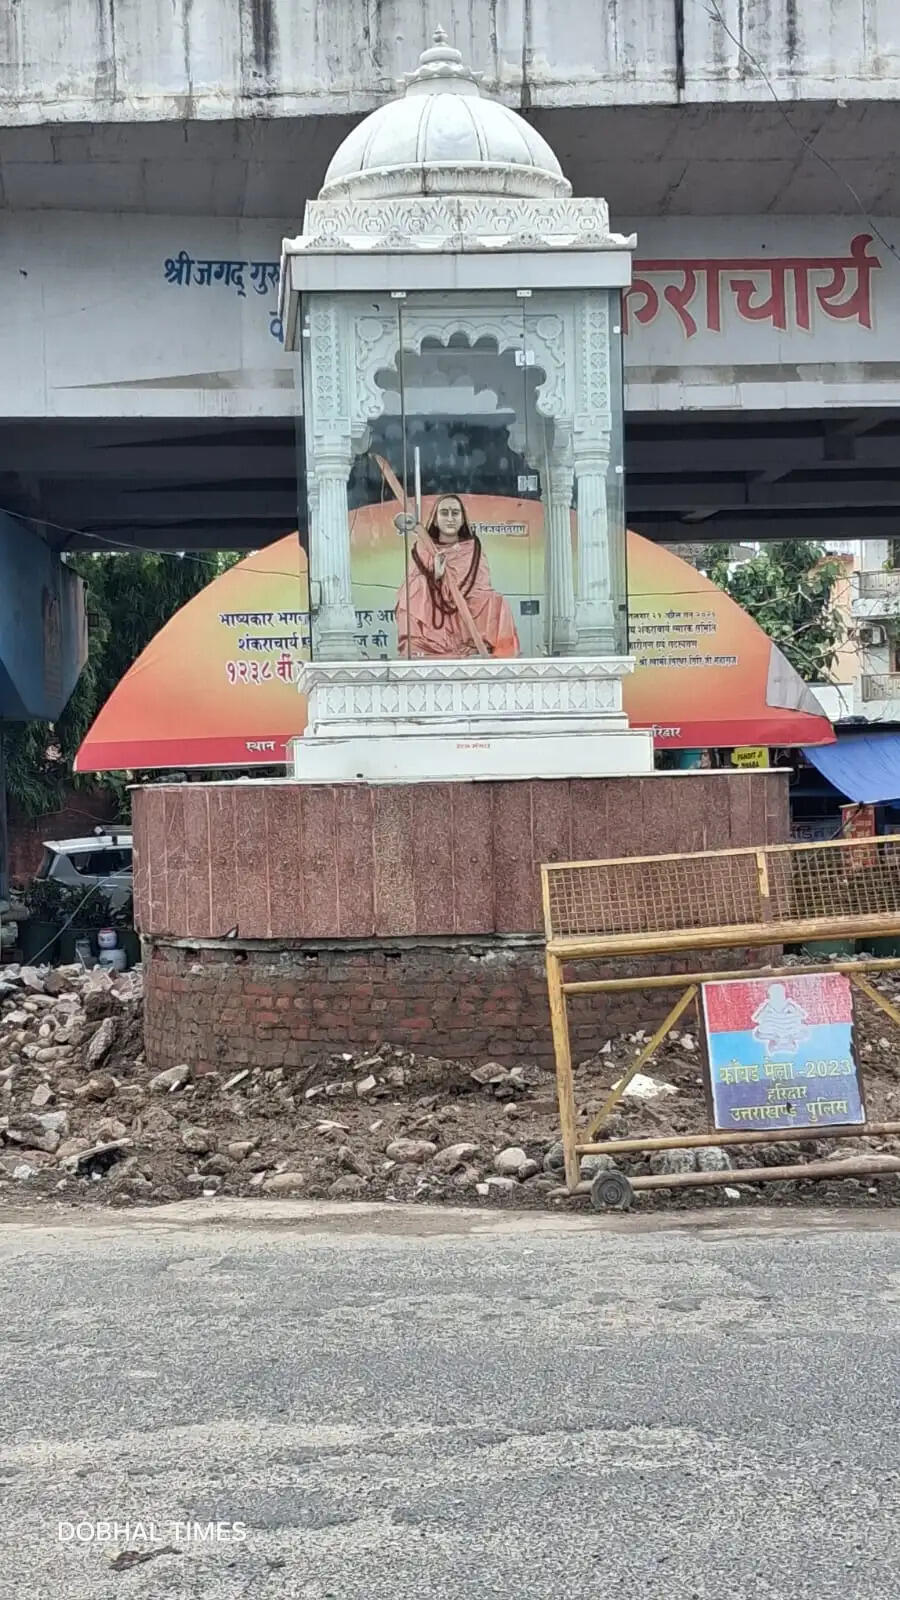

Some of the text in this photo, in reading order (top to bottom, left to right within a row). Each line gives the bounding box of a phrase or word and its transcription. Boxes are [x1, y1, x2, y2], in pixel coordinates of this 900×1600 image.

[622, 233, 882, 339] कराचार्य
[219, 613, 274, 627] भाष्यकार
[238, 632, 299, 651] शंकराचार्य
[371, 630, 388, 648] की
[226, 660, 272, 683] १२३८
[652, 724, 683, 740] रिद्वार
[806, 1097, 848, 1123] पुलिस
